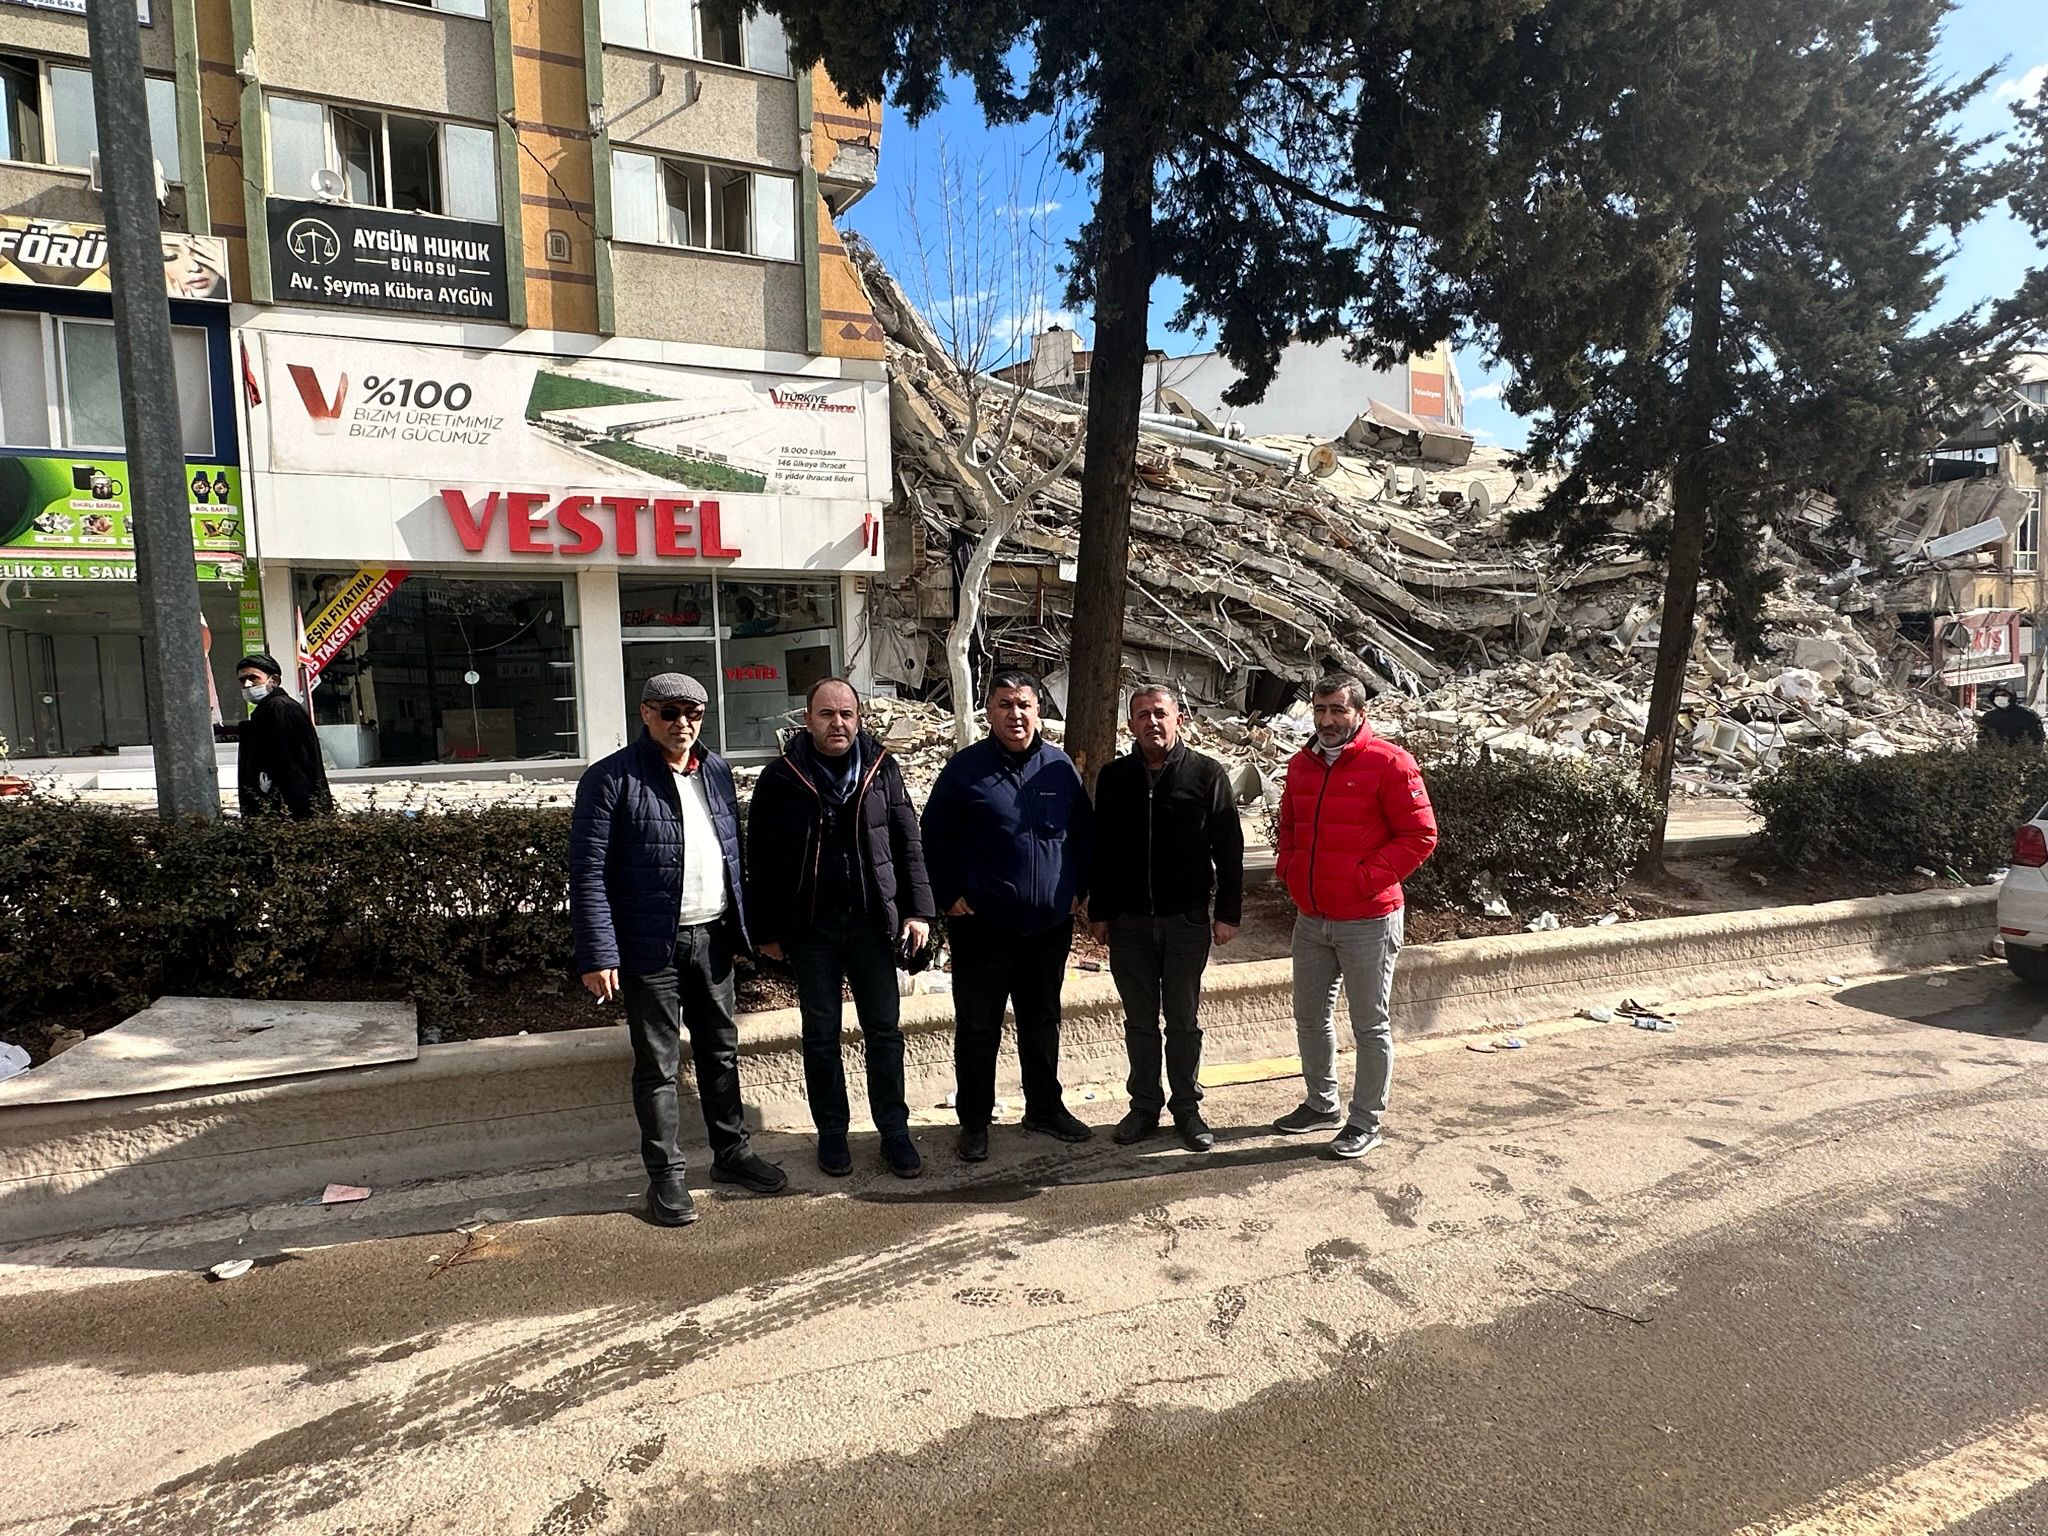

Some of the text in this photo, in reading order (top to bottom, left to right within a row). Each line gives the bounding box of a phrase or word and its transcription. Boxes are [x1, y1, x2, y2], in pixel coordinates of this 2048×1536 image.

[353, 228, 490, 262] AYGÜN HUKUK
[391, 257, 456, 277] BÜROSU
[290, 272, 493, 307] Av. Şeyma Kübra AYGÜN
[362, 375, 472, 411] %100
[401, 426, 491, 445] GÜCÜMÜZ
[777, 459, 791, 467] 146
[819, 461, 846, 470] ihracat
[781, 446, 836, 457] 15.000 çalışan
[775, 472, 783, 480] 15
[806, 473, 833, 482] ihracat
[440, 489, 742, 558] VESTEL
[42, 565, 56, 578] &
[62, 565, 84, 578] EL
[328, 573, 375, 623] FİYATINA
[314, 618, 355, 662] TAKSİT
[351, 577, 394, 625] FIRSATI
